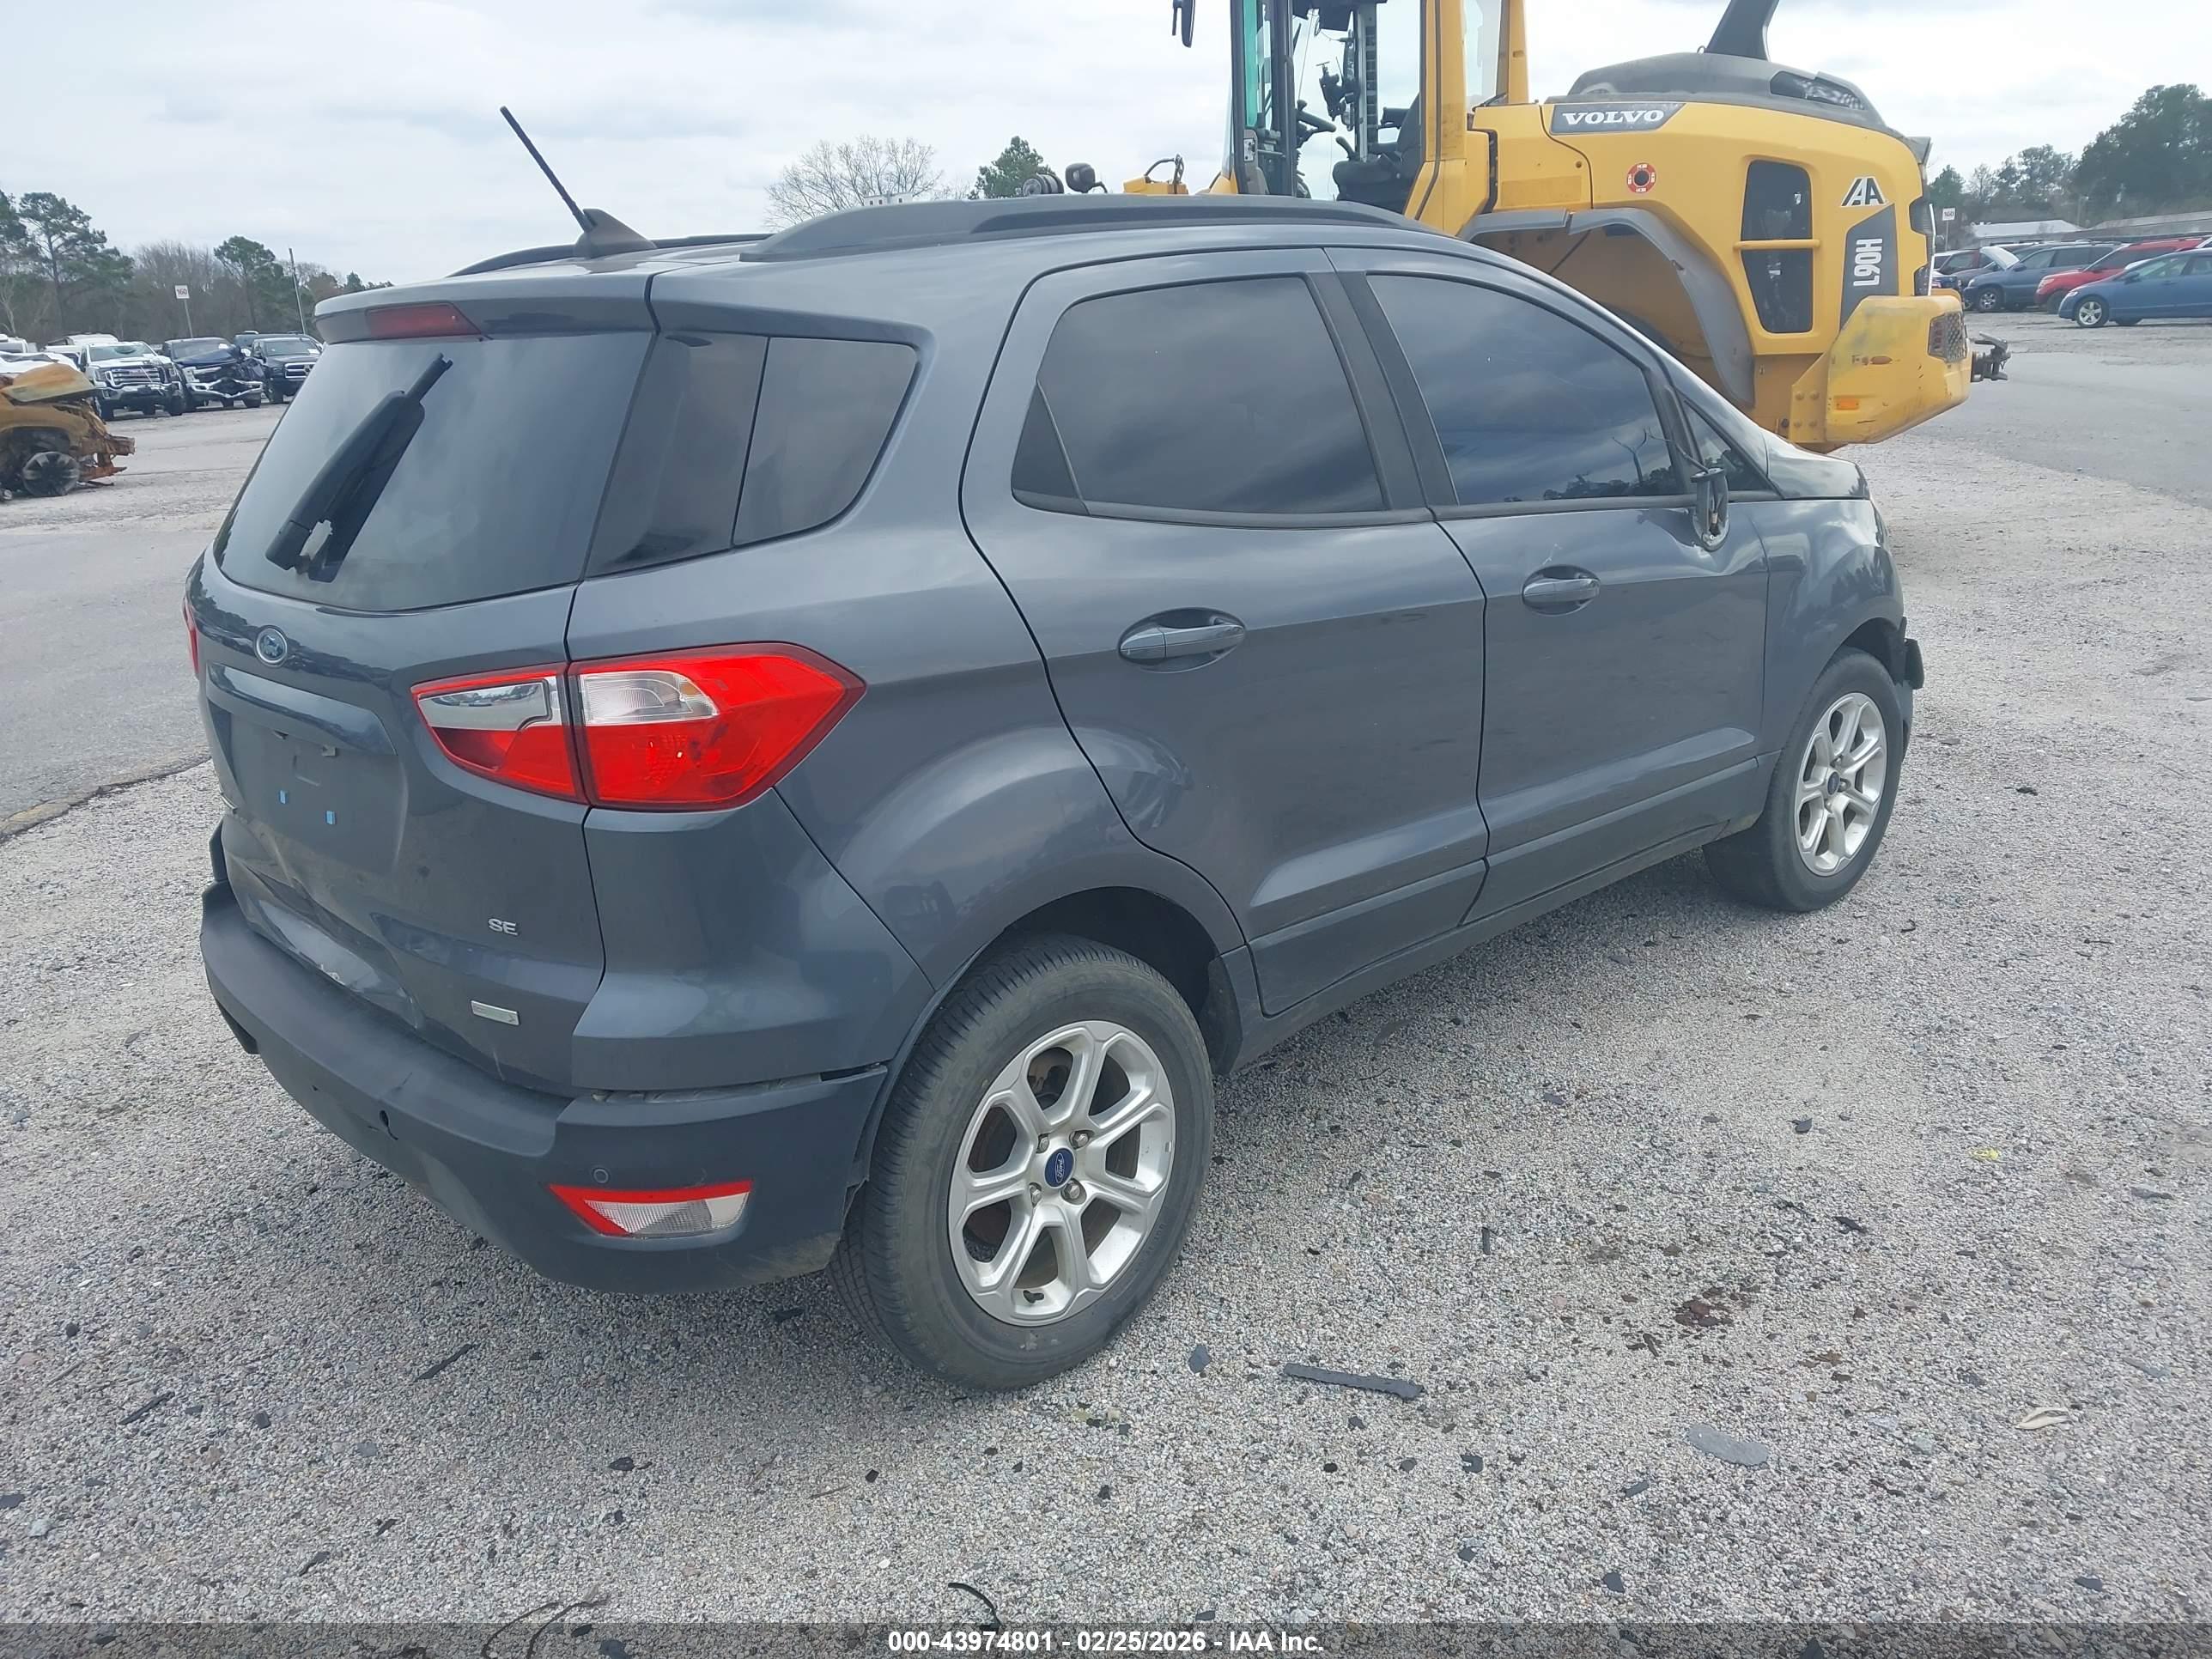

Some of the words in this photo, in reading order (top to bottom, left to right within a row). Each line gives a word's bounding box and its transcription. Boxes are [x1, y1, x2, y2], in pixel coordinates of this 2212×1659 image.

[1562, 109, 1664, 125] VOLVO
[1853, 238, 1883, 286] L90H
[488, 918, 519, 936] SE
